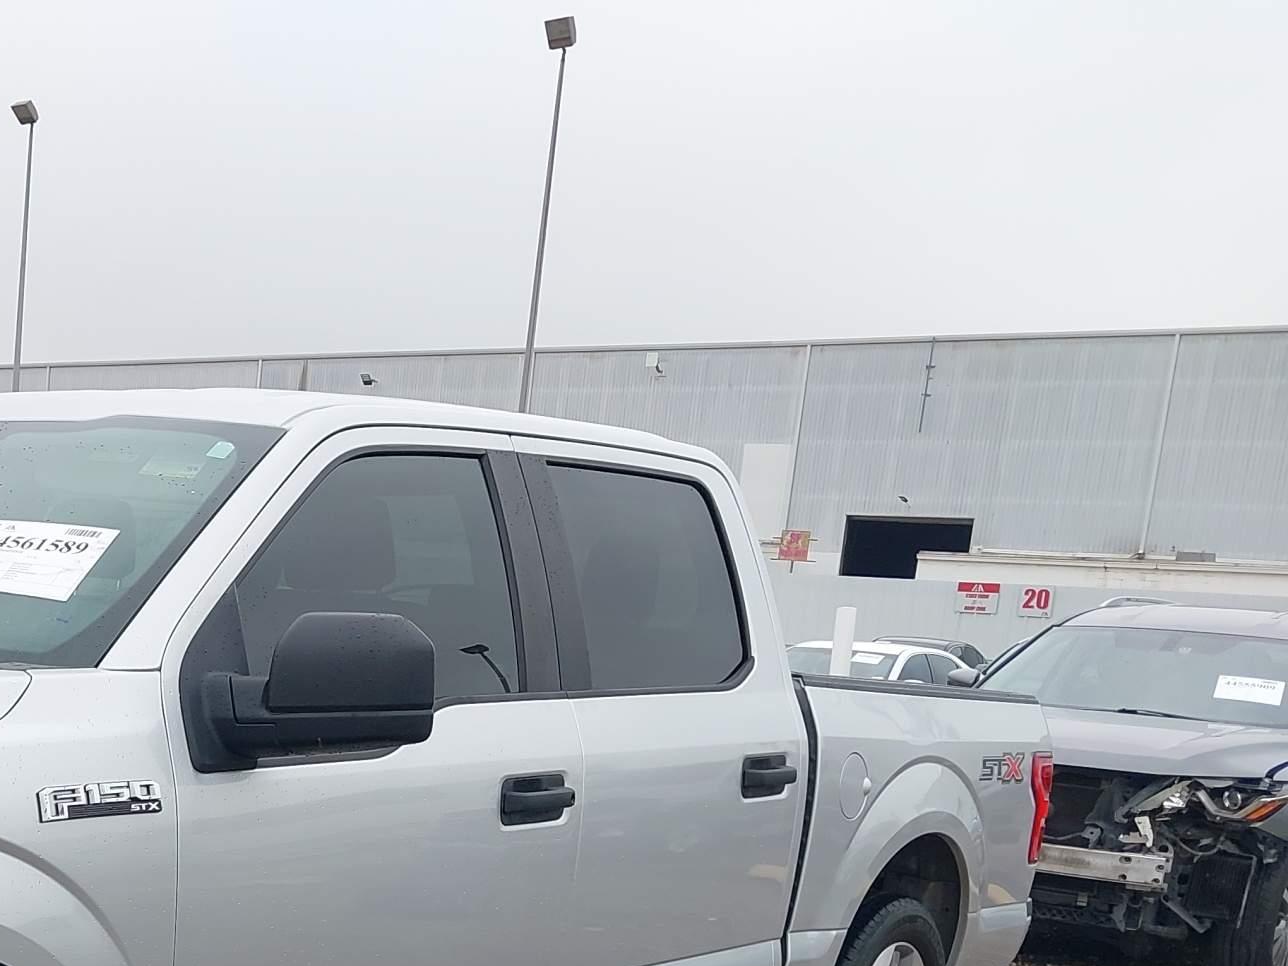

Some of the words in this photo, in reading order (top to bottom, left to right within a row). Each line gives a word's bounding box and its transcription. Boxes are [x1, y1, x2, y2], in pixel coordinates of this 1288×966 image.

[1022, 588, 1050, 610] 20
[978, 752, 1025, 784] STX
[130, 801, 161, 812] STX
